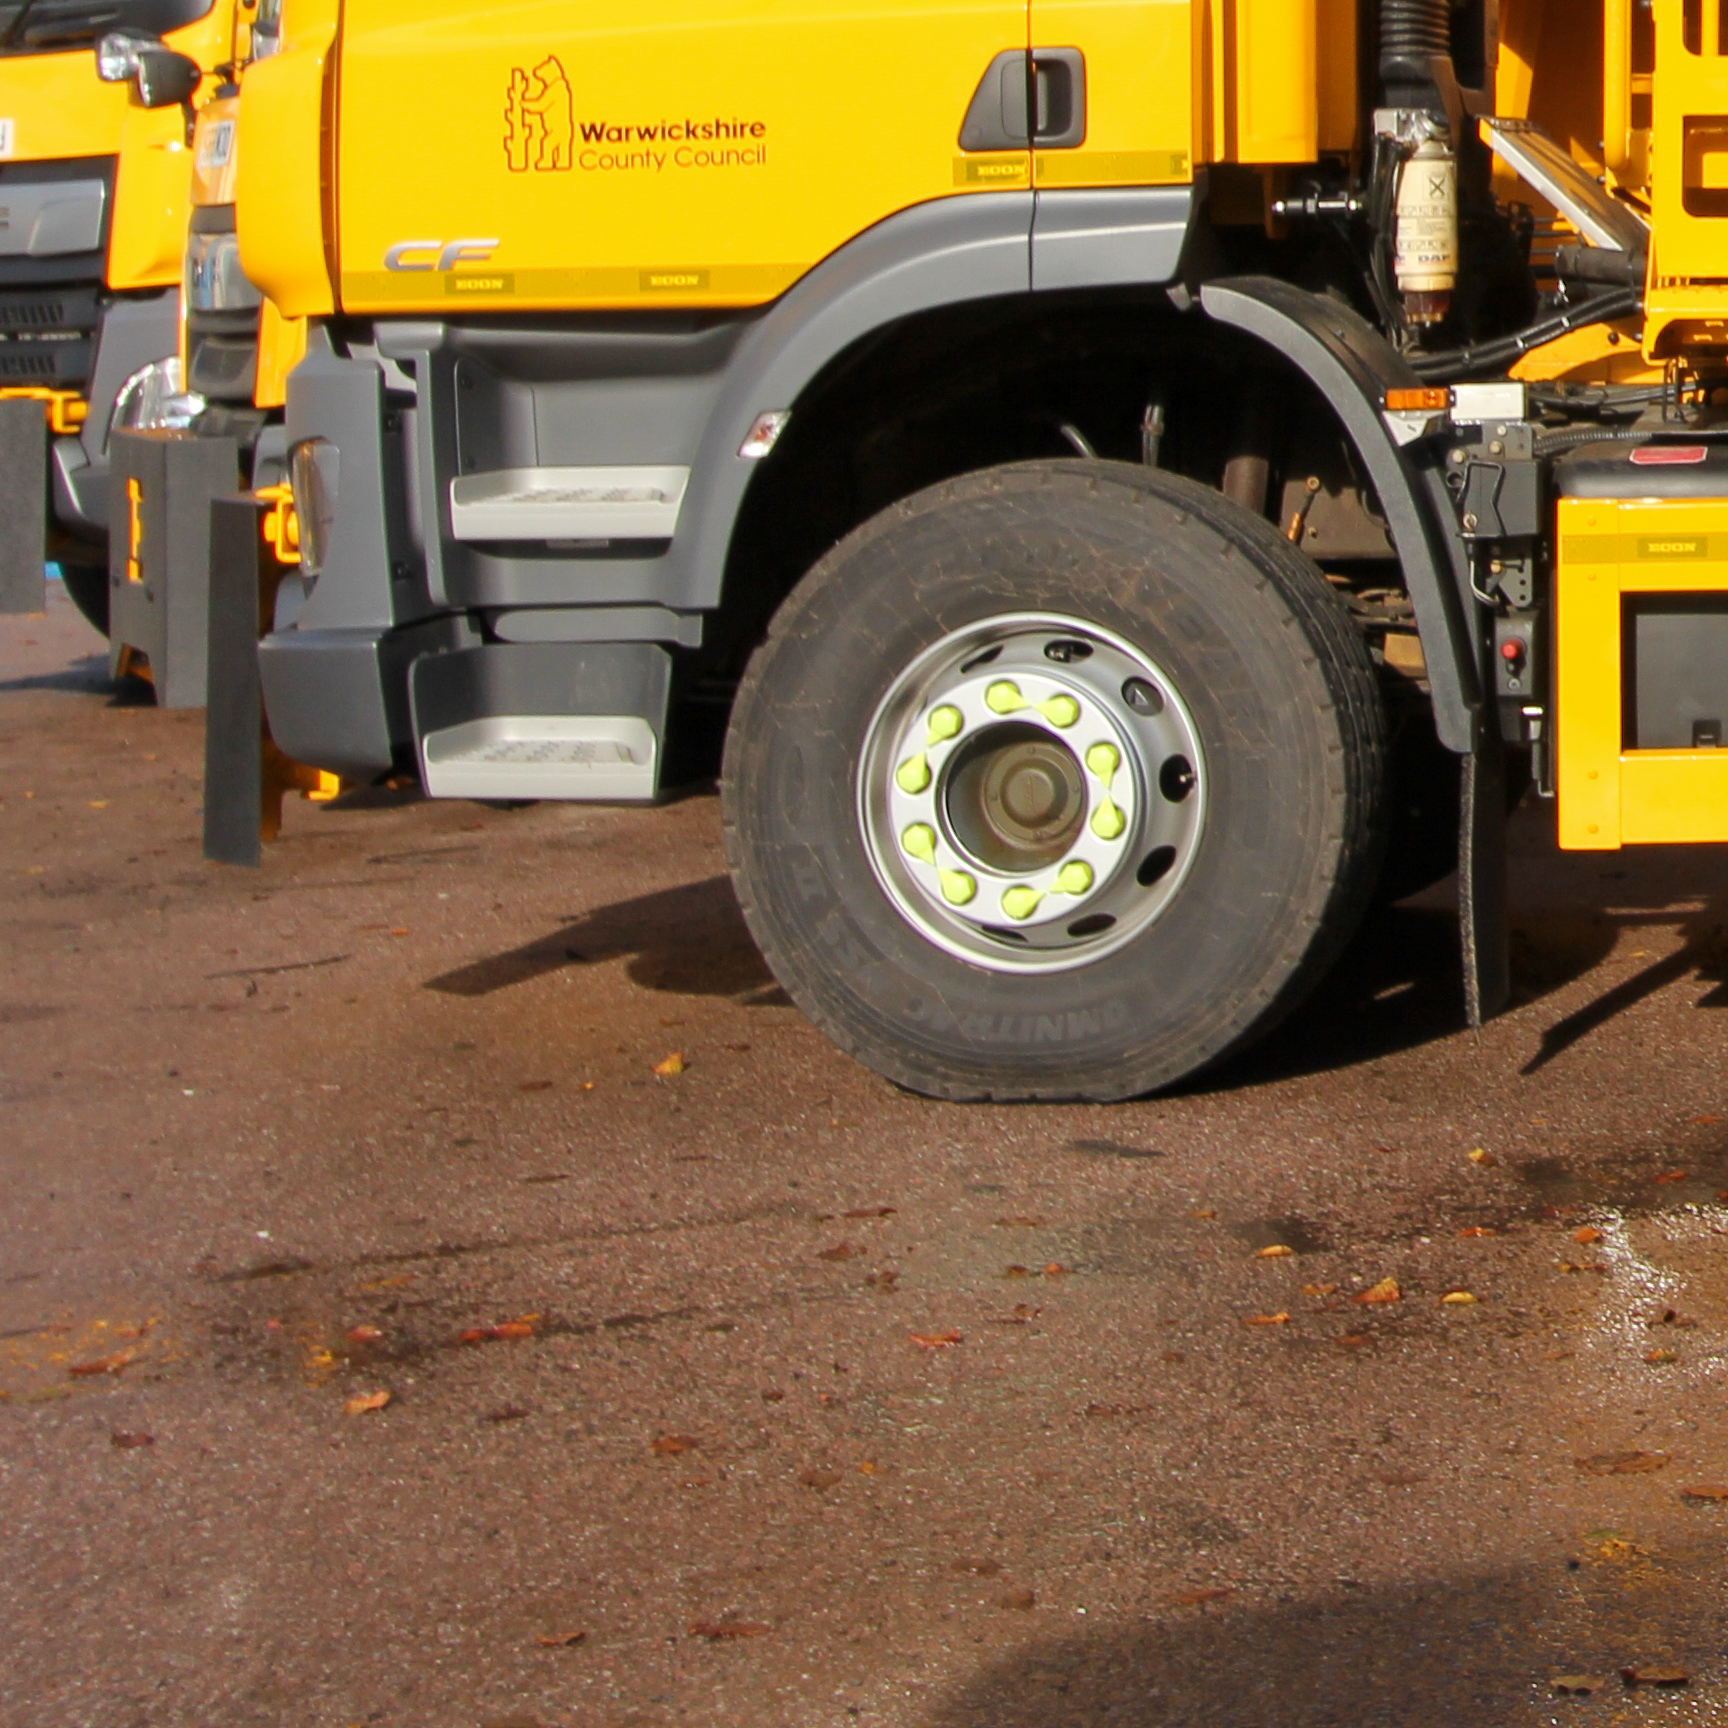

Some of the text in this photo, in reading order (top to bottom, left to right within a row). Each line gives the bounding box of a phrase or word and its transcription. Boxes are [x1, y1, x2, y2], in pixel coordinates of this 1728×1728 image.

[580, 116, 767, 143] Warwickshire
[579, 144, 767, 172] County Council
[384, 238, 500, 272] CF
